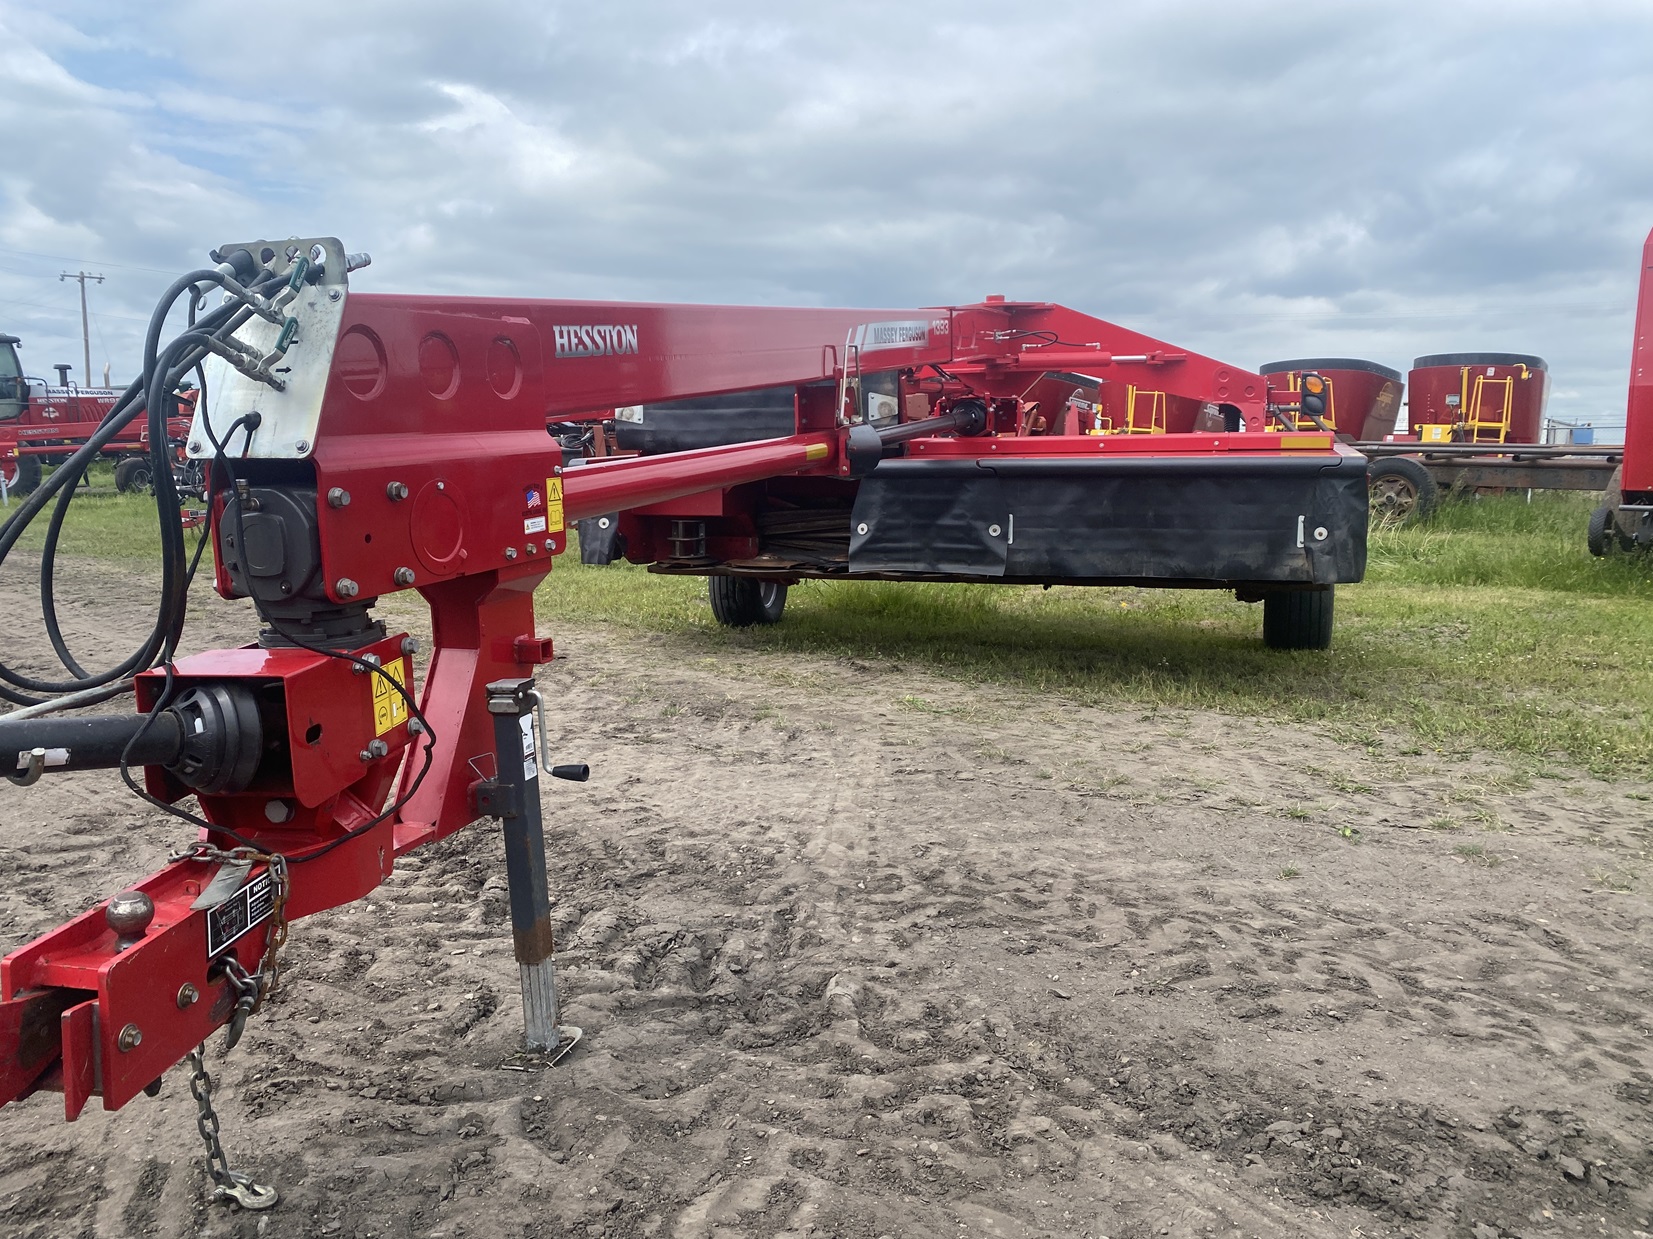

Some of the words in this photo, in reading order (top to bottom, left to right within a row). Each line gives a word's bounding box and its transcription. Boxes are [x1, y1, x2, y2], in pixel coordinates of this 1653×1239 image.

[553, 324, 638, 359] HESSTON
[874, 327, 898, 344] MASSEY
[899, 326, 926, 343] FERGUSON
